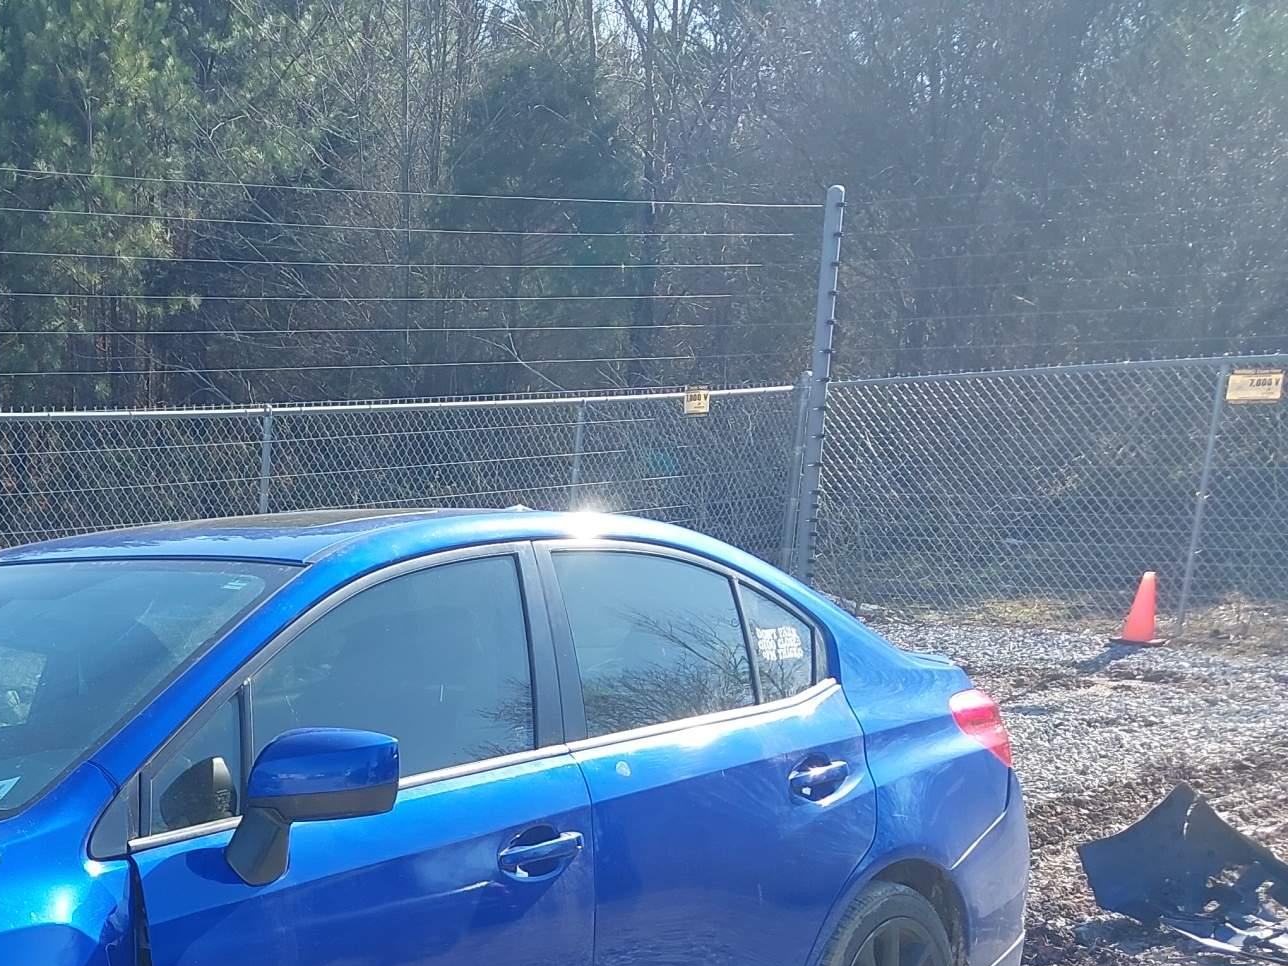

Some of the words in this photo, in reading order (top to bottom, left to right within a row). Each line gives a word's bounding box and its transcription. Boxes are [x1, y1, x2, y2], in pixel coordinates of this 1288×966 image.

[1249, 379, 1272, 387] 7,000
[1275, 377, 1281, 386] V
[704, 393, 709, 401] V
